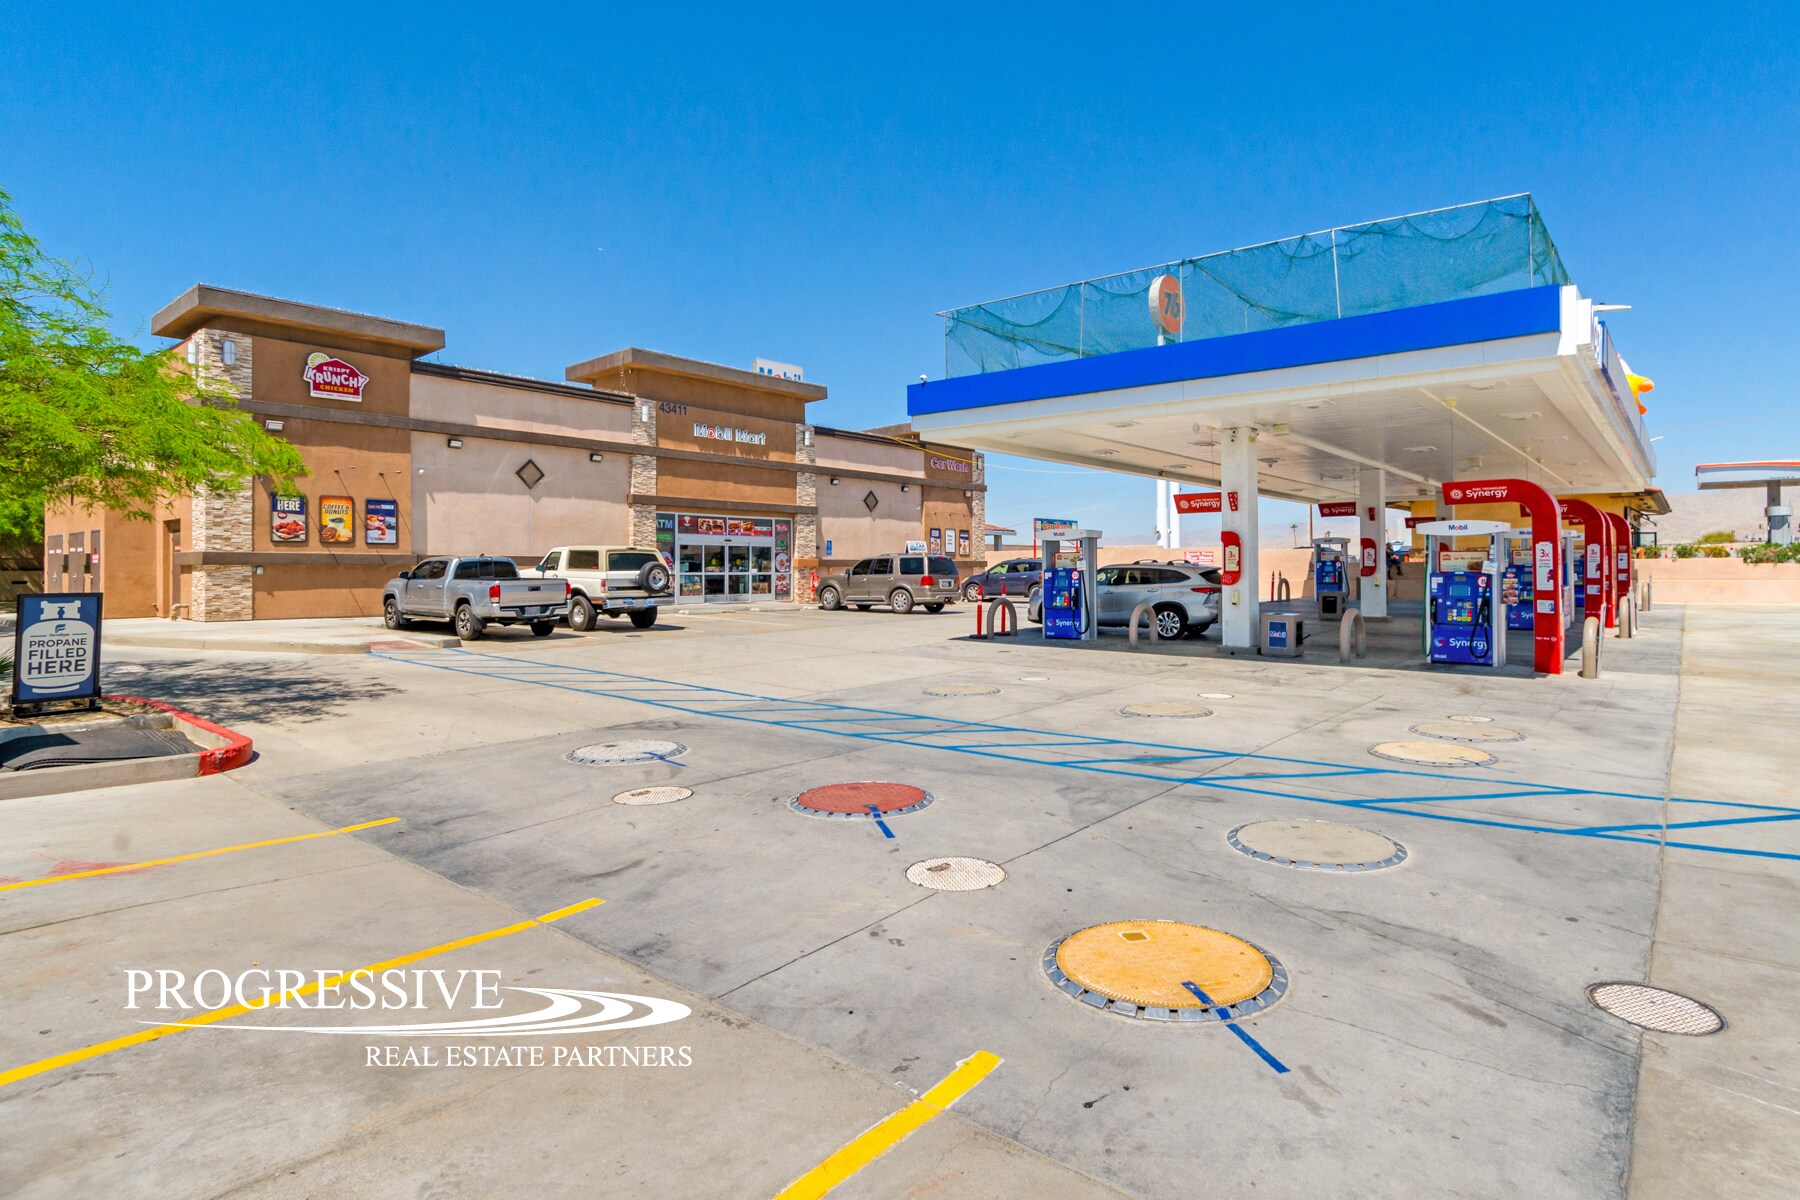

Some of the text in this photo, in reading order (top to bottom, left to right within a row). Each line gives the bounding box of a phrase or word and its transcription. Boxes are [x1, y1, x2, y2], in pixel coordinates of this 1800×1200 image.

[1164, 291, 1180, 319] 76
[322, 366, 350, 374] KRISPY
[306, 368, 367, 388] KRUNCHY
[320, 385, 354, 393] CHICKEN
[658, 402, 687, 416] 43411
[693, 423, 766, 446] Mobil Mart
[931, 457, 969, 473] Car Wash
[1466, 488, 1508, 499] Synergy
[277, 500, 300, 511] HERE
[1190, 500, 1220, 509] Synergy
[1540, 549, 1550, 558] 3x
[1269, 630, 1287, 638] Mobil
[29, 638, 87, 648] PROPANE
[28, 647, 87, 660] FILLED
[27, 659, 86, 675] HERE
